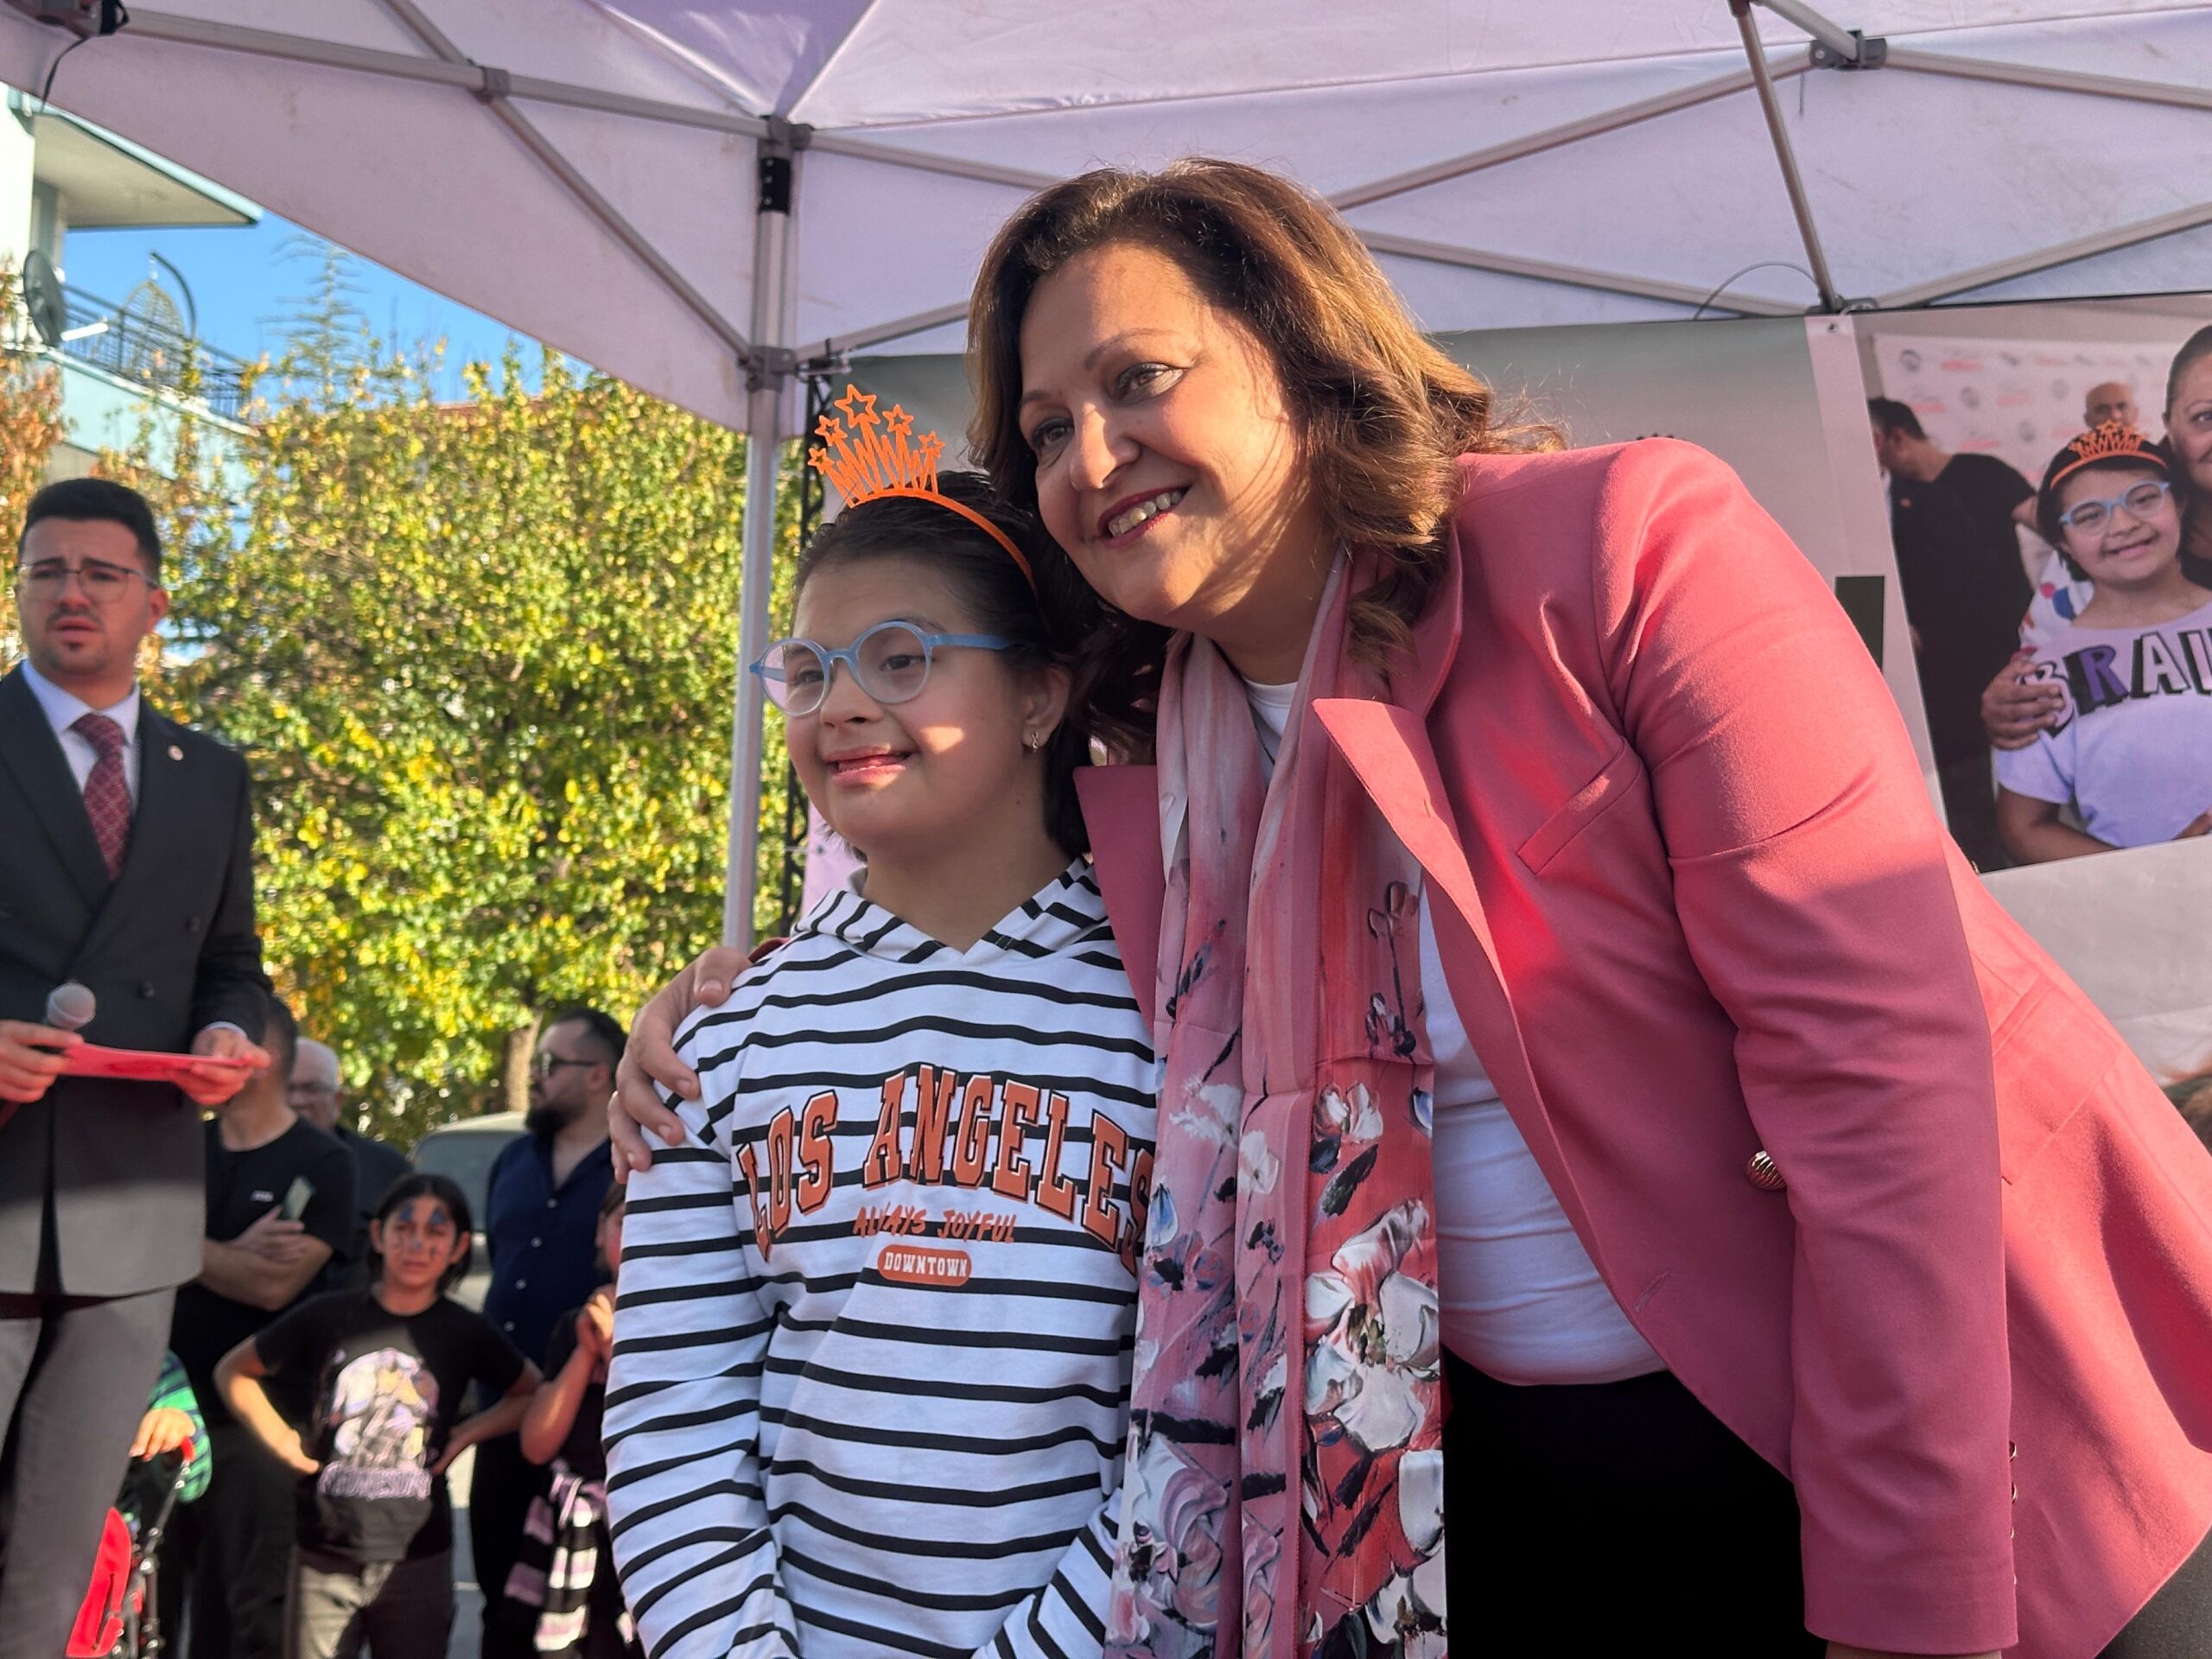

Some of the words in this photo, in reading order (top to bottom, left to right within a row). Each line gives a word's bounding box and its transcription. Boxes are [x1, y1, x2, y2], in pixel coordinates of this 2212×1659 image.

[2016, 628, 2212, 739] BRAI
[736, 1089, 839, 1264] LOS
[863, 1064, 1155, 1280] ANGELES
[937, 1209, 1017, 1243] JOYFUL
[883, 1251, 968, 1277] DOWNTOWN
